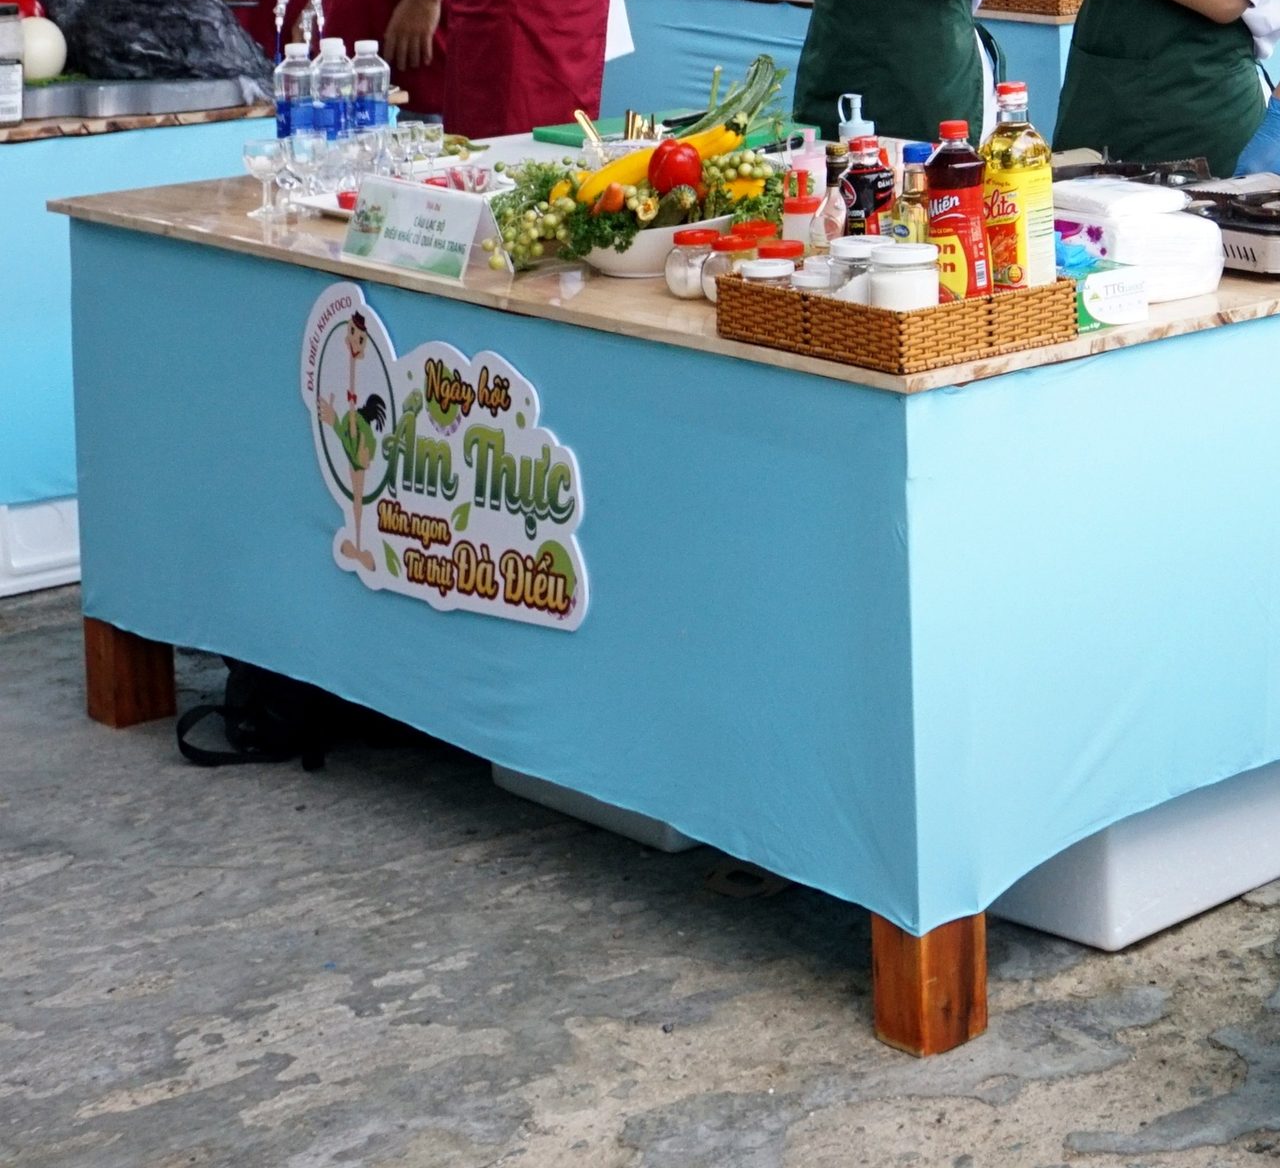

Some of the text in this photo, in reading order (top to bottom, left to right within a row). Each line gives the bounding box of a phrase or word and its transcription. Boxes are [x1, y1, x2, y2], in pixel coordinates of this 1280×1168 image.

[434, 238, 446, 250] NHA
[446, 241, 467, 256] TRANG
[306, 295, 352, 392] ĐÀ ĐIỂU KHATOCO
[425, 358, 511, 417] Ngày hội
[463, 423, 576, 541] Thực
[377, 498, 451, 549] Món ngon
[403, 547, 455, 598] Từ thịt
[452, 539, 571, 615] Đà Điểu
